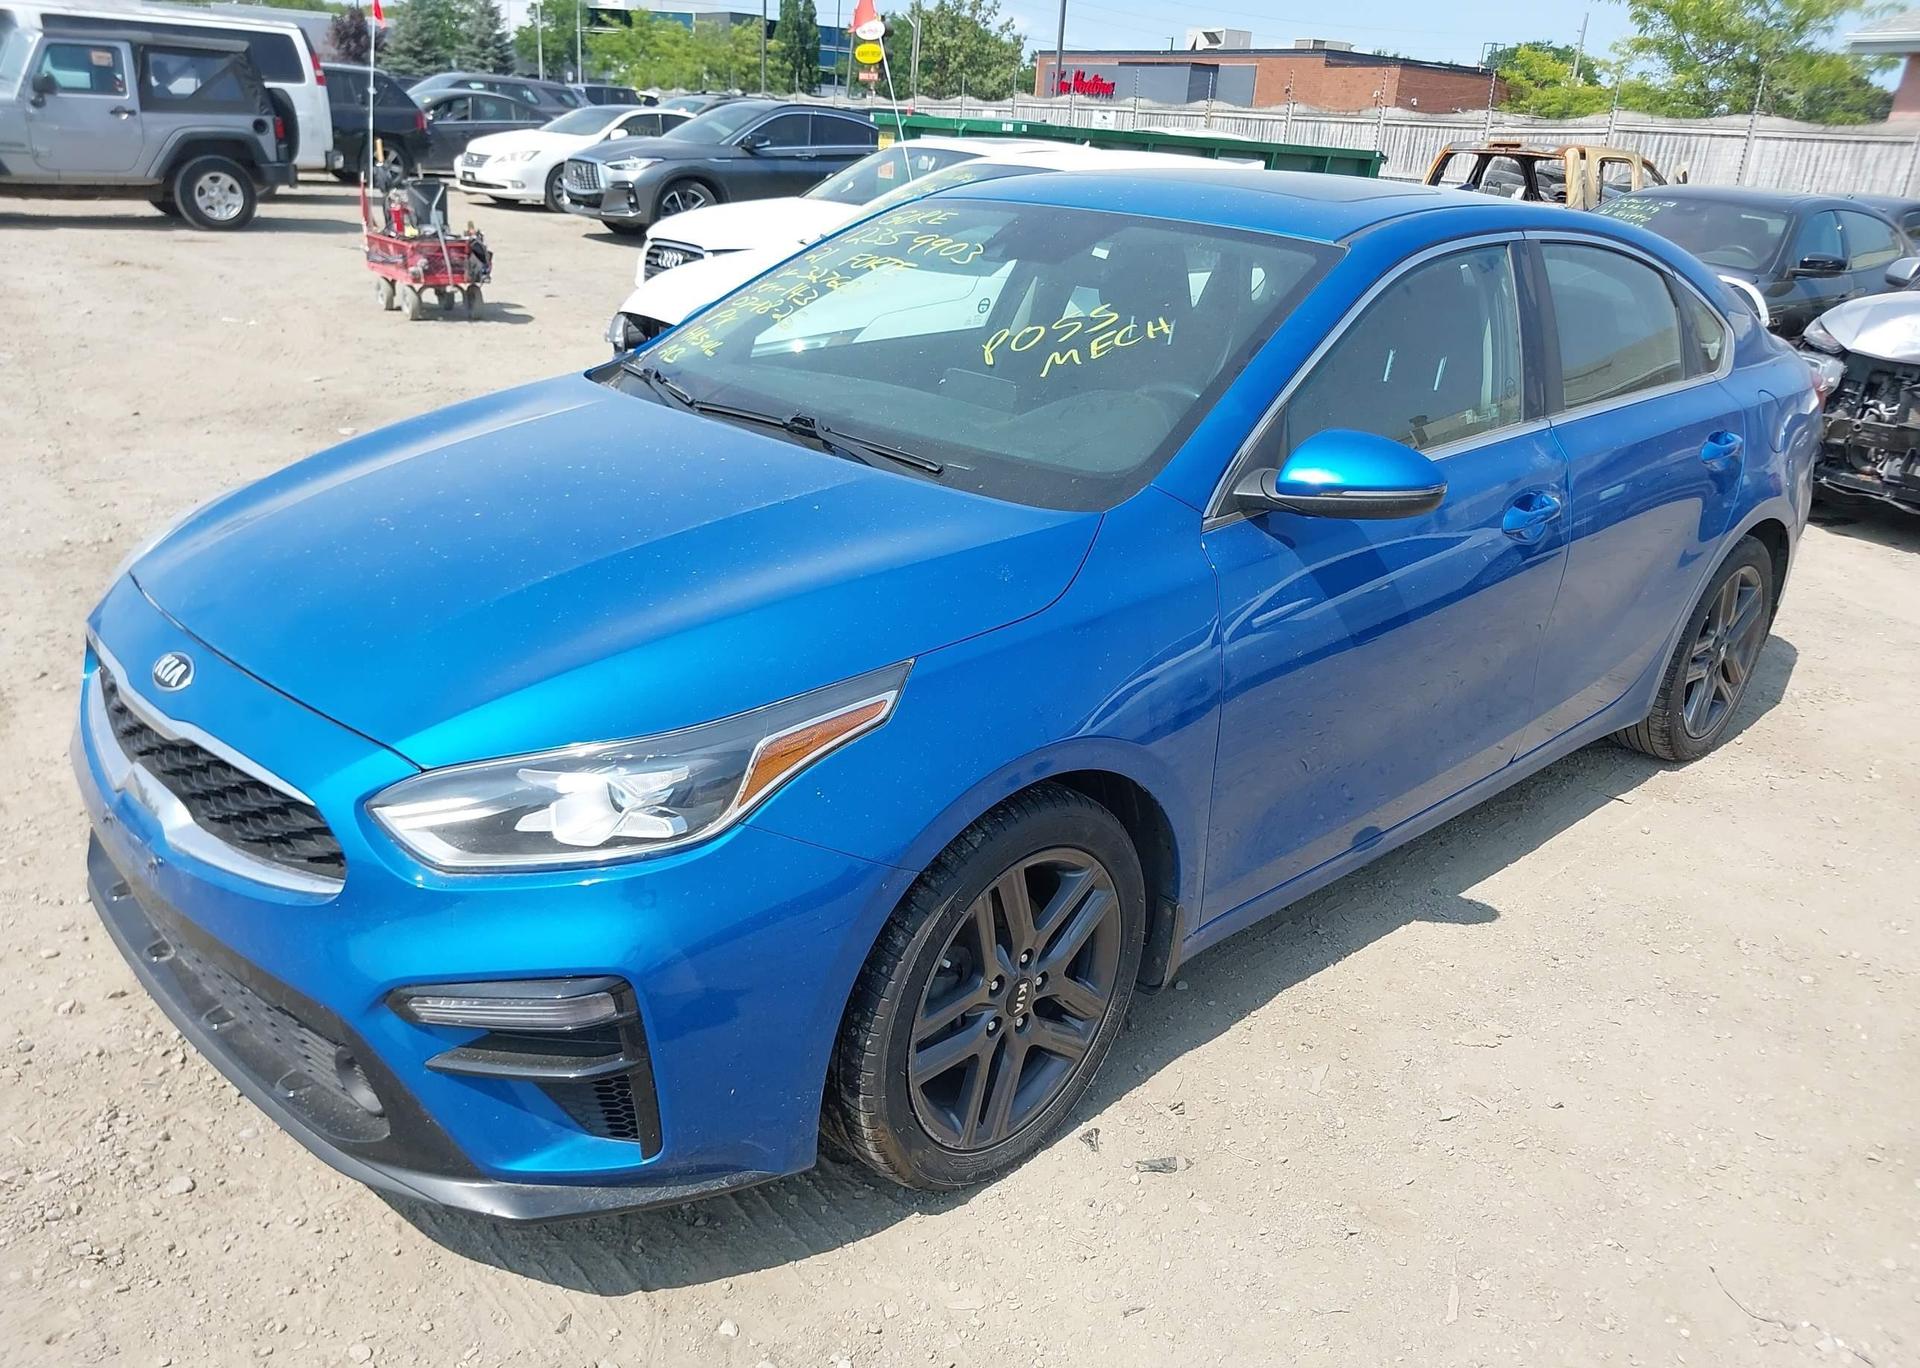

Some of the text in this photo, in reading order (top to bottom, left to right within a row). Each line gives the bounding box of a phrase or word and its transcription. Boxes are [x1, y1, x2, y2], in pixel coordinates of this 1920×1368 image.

[907, 234, 984, 265] 9903
[982, 303, 1119, 365] POSS
[1039, 316, 1172, 378] MECH
[154, 653, 188, 688] KIA
[1013, 982, 1028, 1014] KIA
